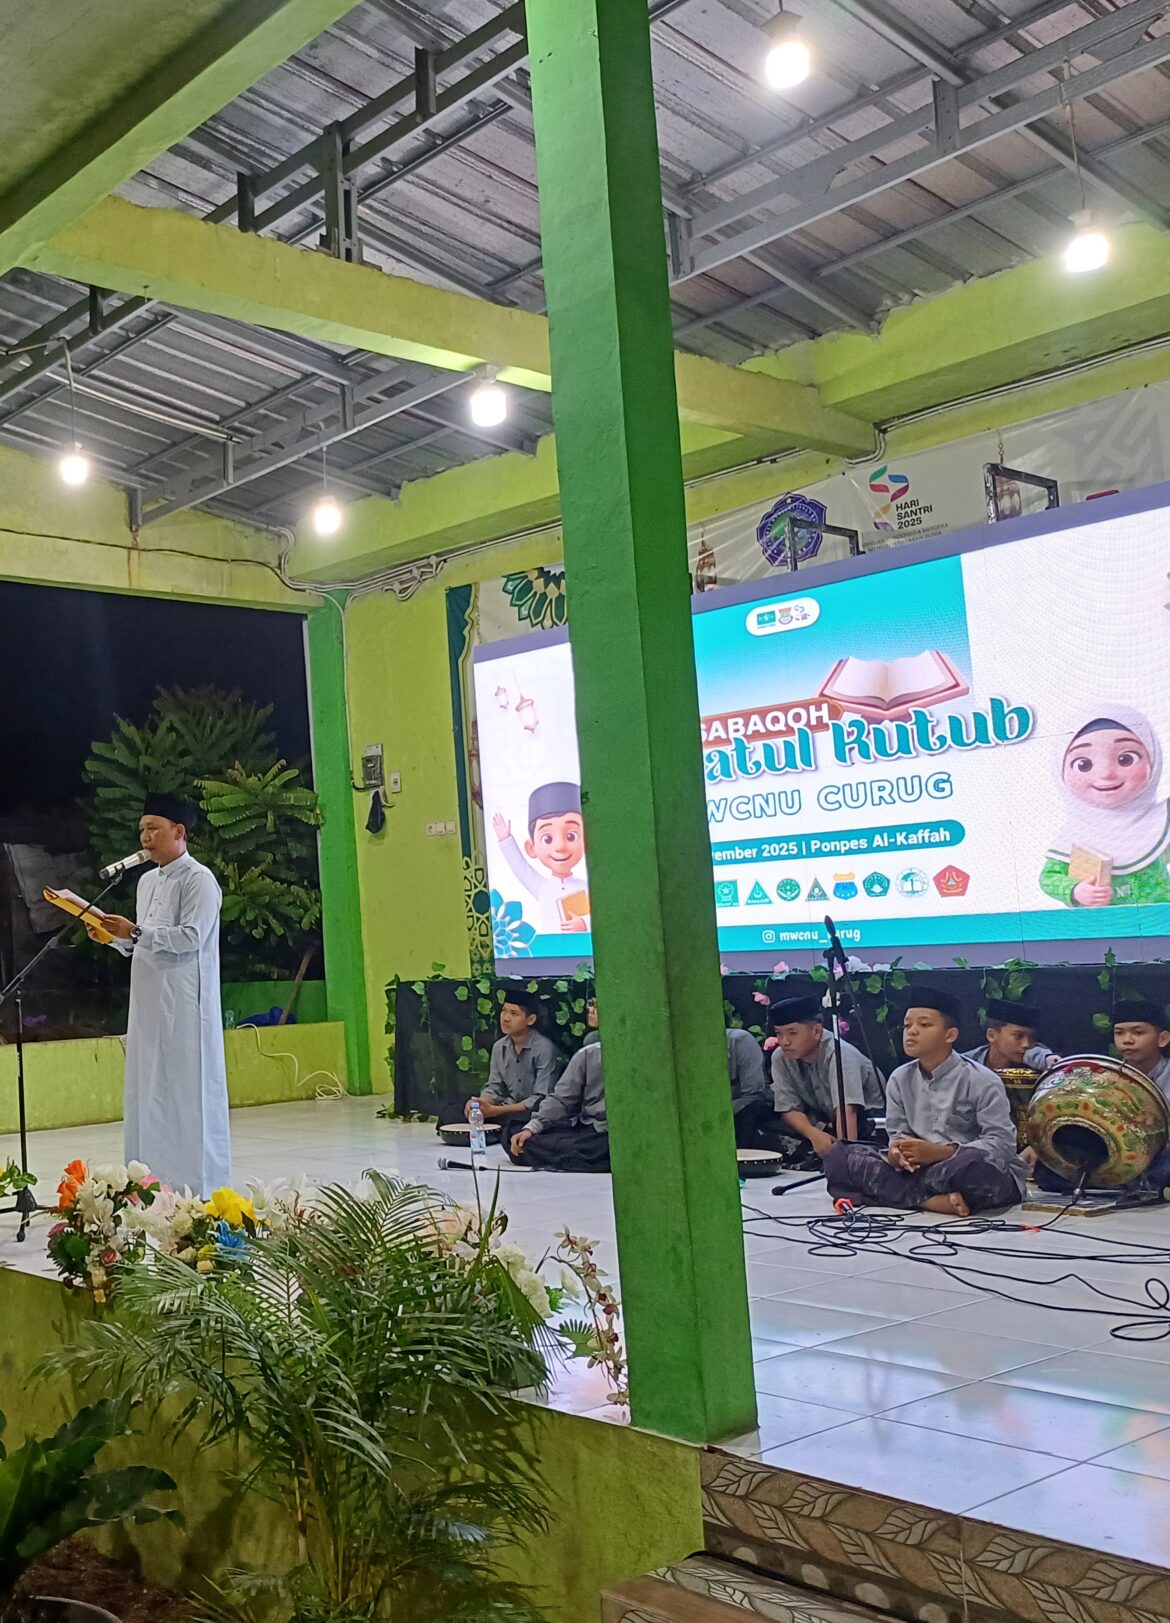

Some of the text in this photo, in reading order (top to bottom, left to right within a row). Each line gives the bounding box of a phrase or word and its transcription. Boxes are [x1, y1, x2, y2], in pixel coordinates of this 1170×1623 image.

[896, 499, 920, 512] HARI
[896, 504, 933, 521] SANTRI
[897, 517, 922, 530] 2025
[704, 725, 814, 783] atul
[816, 771, 954, 812] CURUG
[712, 846, 758, 861] ember
[761, 842, 798, 857] 2025
[810, 837, 868, 854] Ponpes
[872, 827, 951, 848] Al-Kaffah
[779, 928, 861, 943] mwcnu_urug
